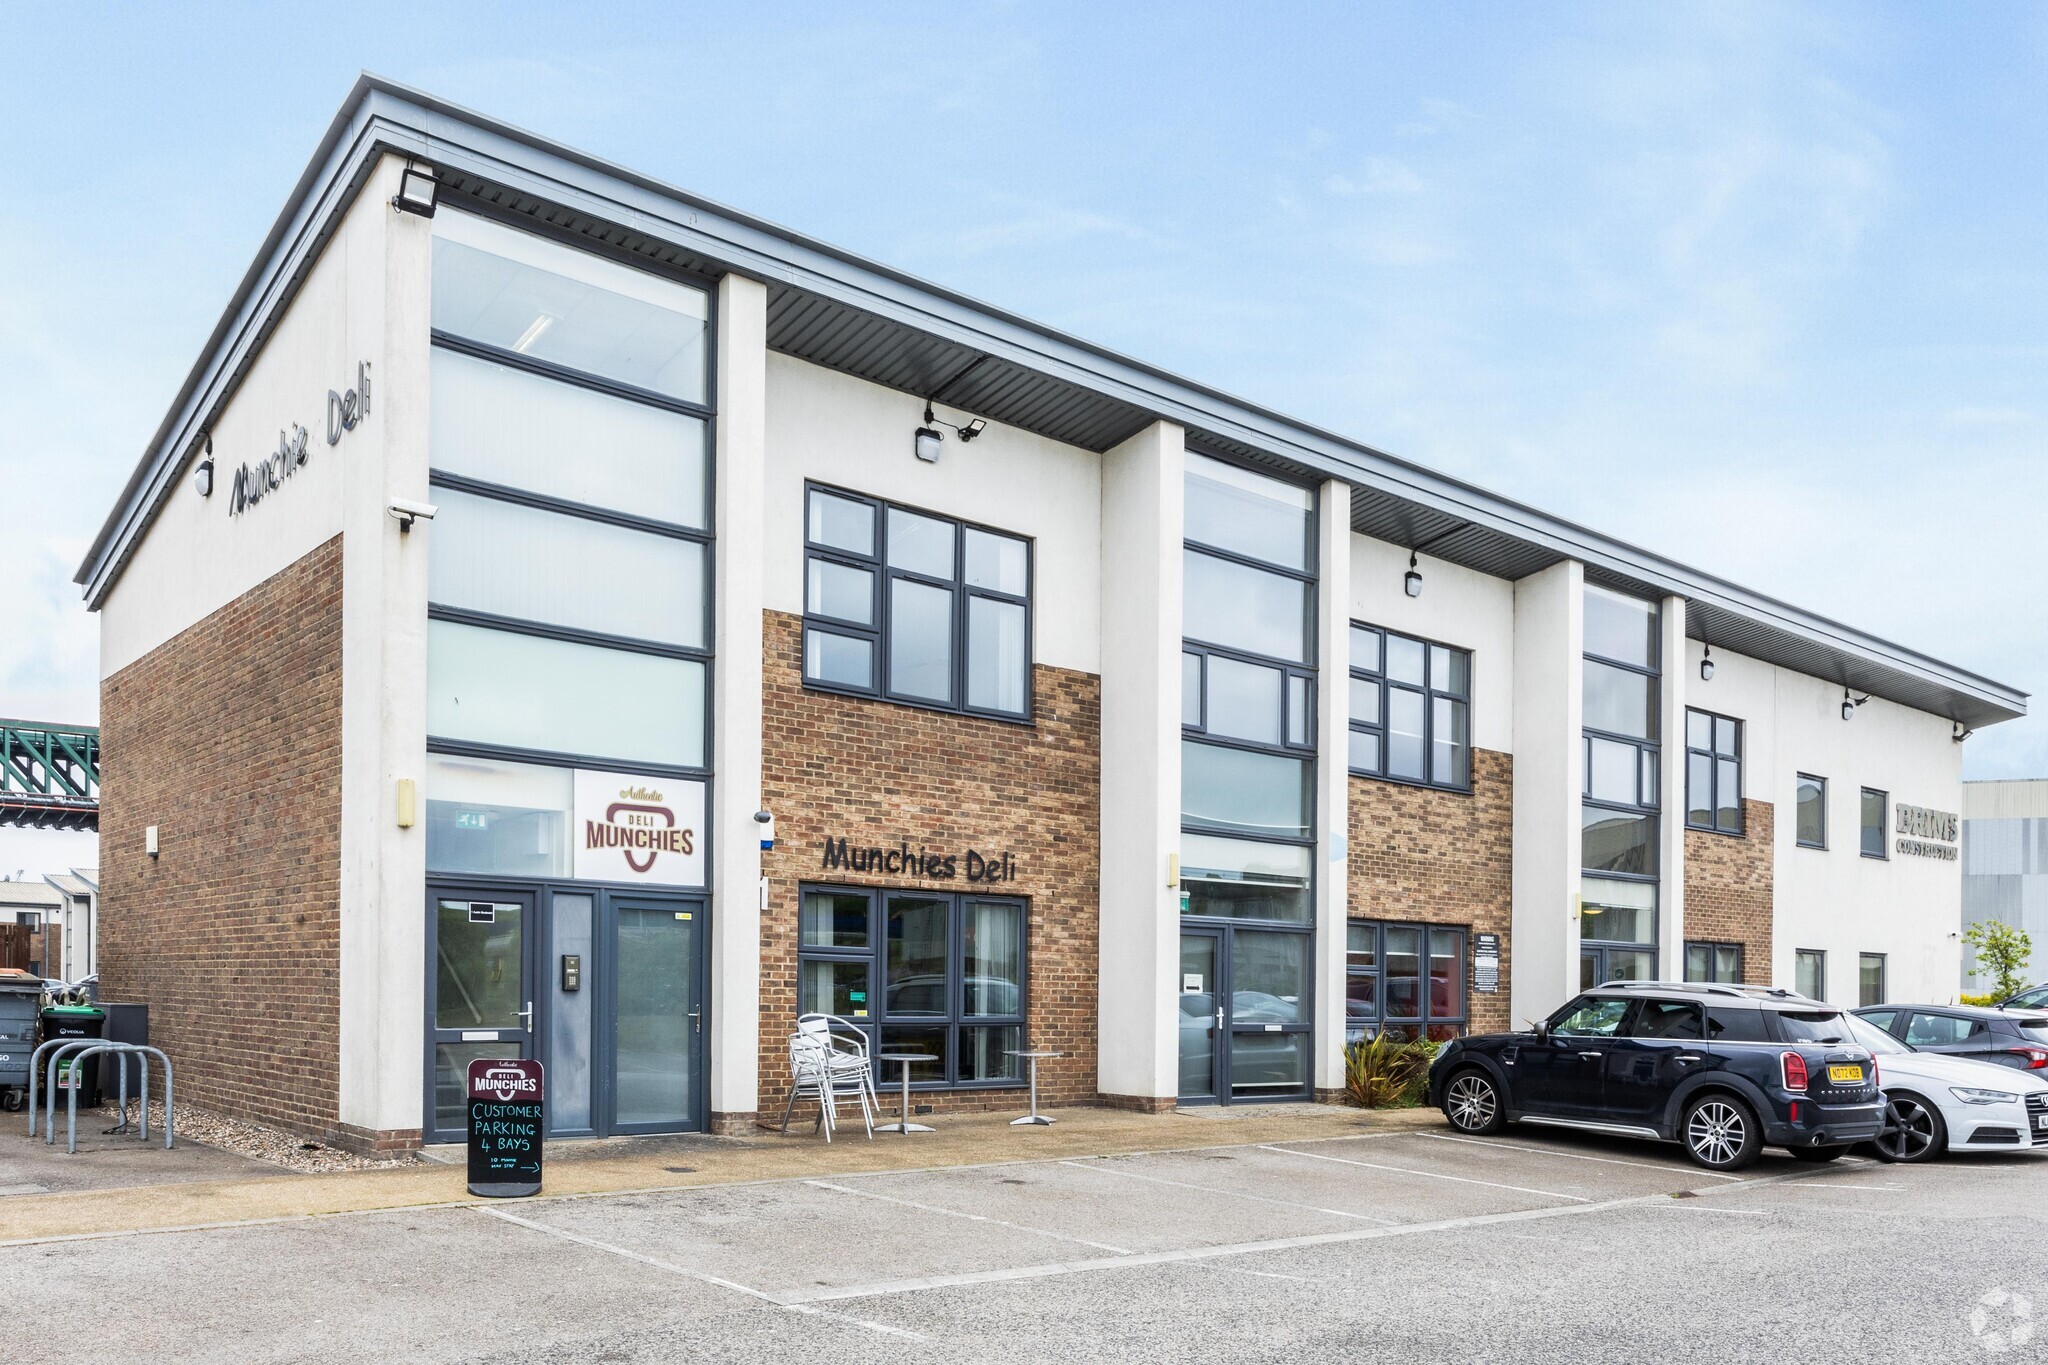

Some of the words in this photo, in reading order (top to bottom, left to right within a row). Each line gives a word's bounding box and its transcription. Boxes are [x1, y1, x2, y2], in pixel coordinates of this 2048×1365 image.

[229, 421, 309, 517] Munchie
[326, 359, 371, 446] Deli
[619, 786, 663, 802] Authentic
[628, 814, 654, 827] DELI
[1896, 803, 1958, 842] BRIMS
[586, 819, 694, 856] MUNCHIES
[1896, 838, 1959, 861] CONSTRUCTION
[823, 837, 957, 878] Munchies
[966, 848, 1016, 881] Deli
[475, 1077, 536, 1092] MUNCHIES
[472, 1103, 543, 1120] CUSTOMER
[475, 1121, 536, 1136] PARKING
[481, 1138, 491, 1153] 4
[498, 1137, 530, 1151] BAYS
